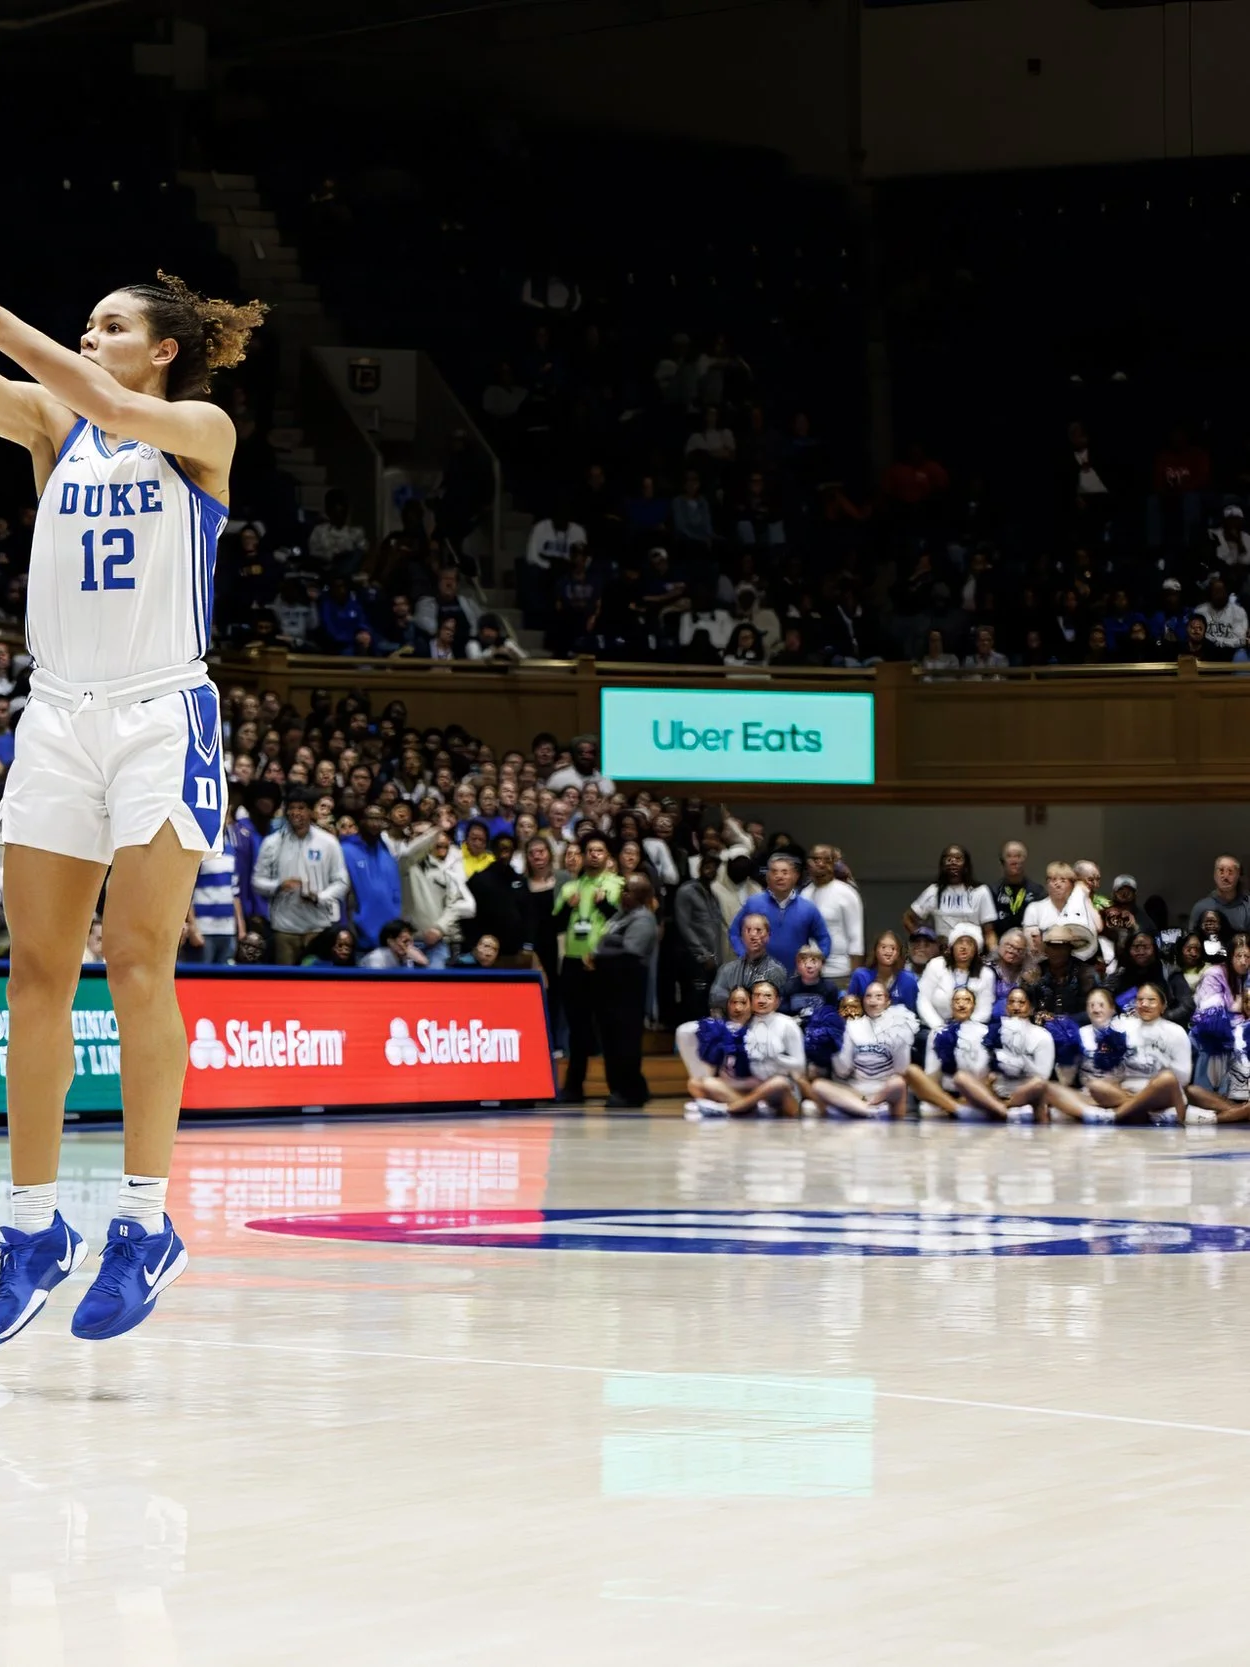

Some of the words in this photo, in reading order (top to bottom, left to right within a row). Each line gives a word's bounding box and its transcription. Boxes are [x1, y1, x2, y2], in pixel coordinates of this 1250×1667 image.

[60, 480, 163, 518] DUKE
[81, 528, 136, 591] 12
[652, 719, 735, 752] Uber
[741, 721, 823, 753] Eats
[193, 776, 218, 811] D
